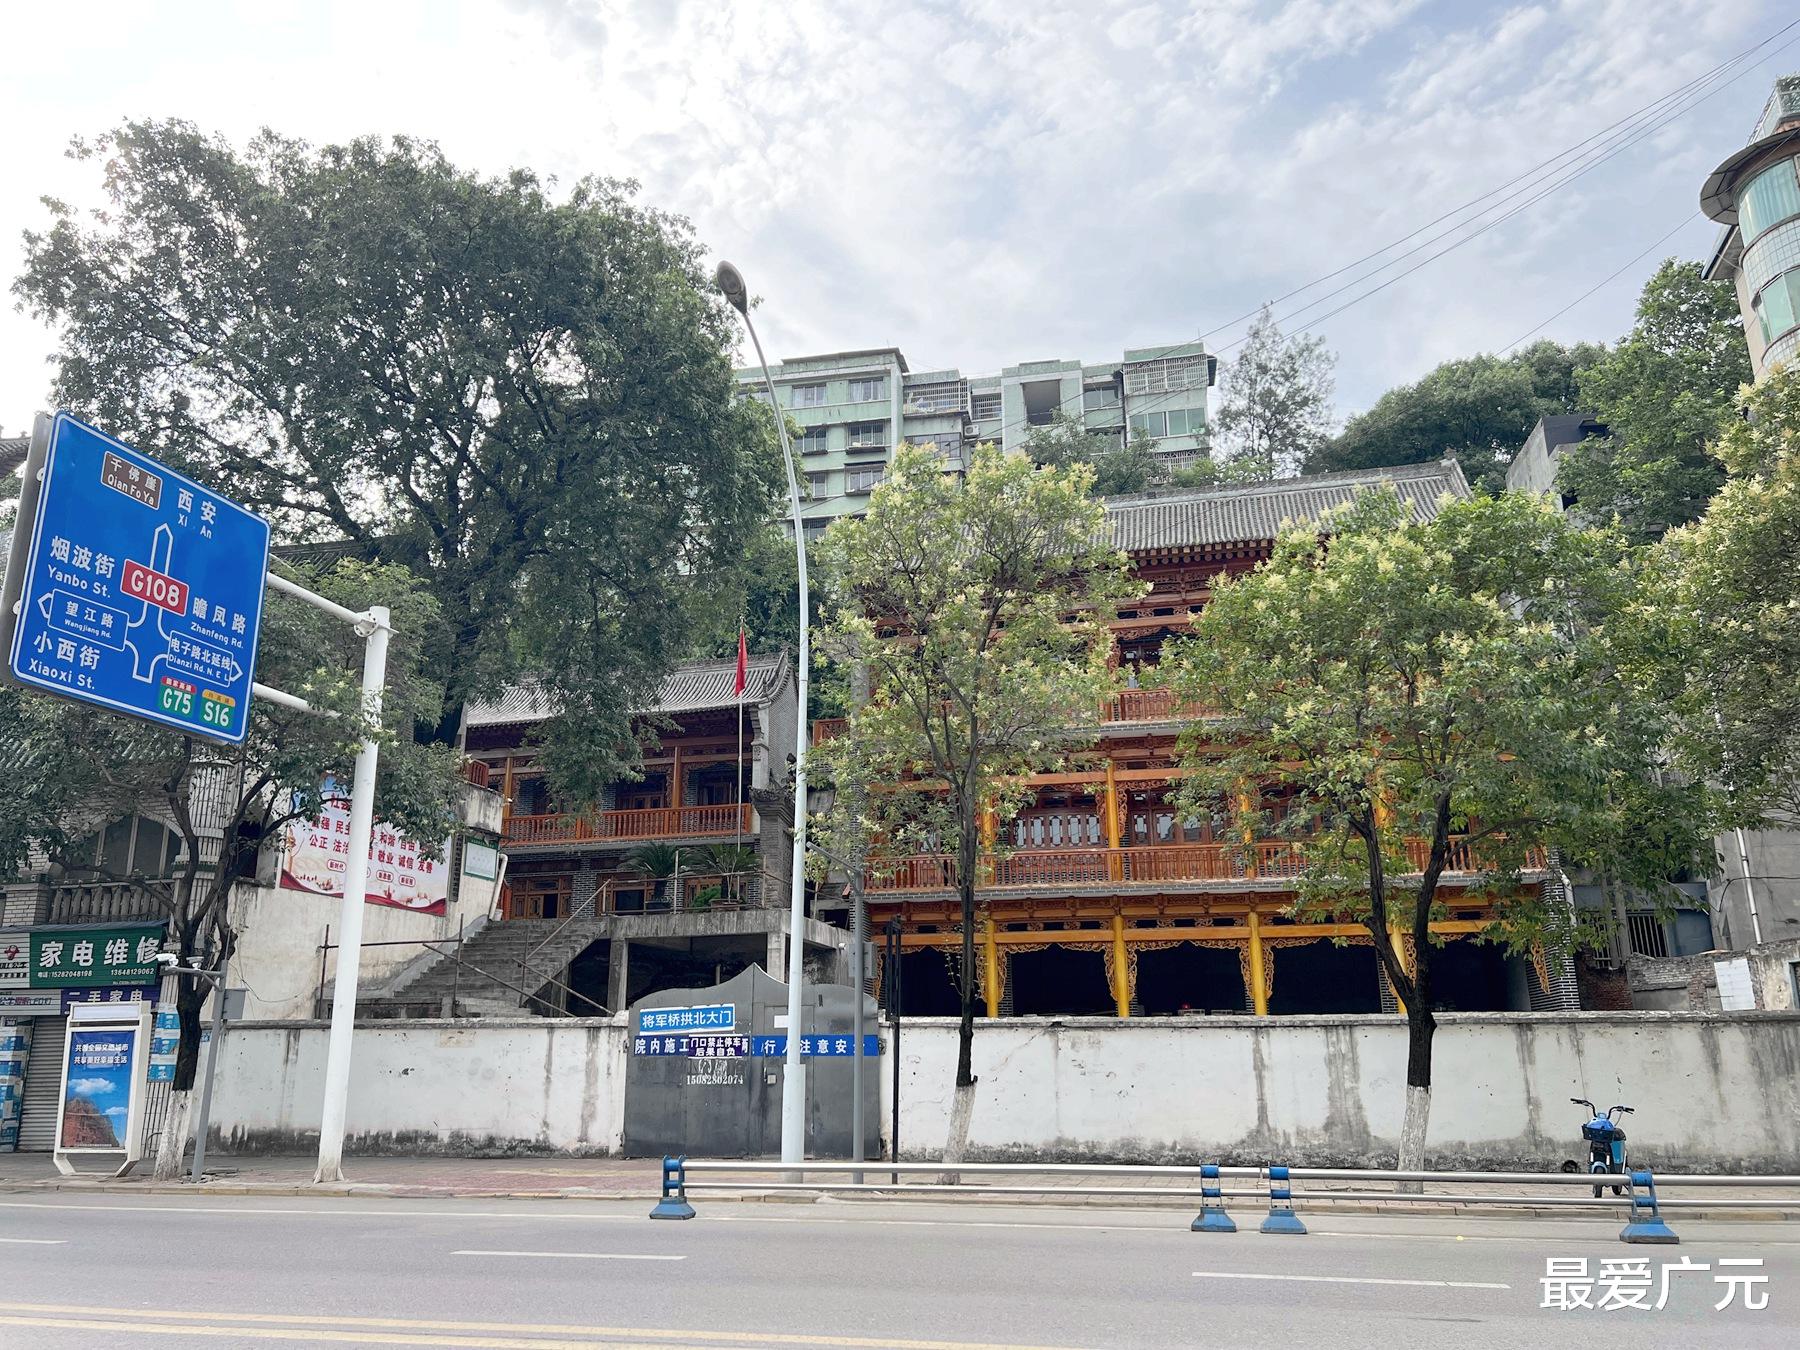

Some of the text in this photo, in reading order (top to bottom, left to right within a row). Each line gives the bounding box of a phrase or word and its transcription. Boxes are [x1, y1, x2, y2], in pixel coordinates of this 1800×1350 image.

[110, 457, 157, 491] 千佛崖
[107, 474, 154, 506] Qian Fo Ya
[177, 487, 216, 525] 西安
[200, 525, 212, 539] An
[50, 535, 115, 579] 烟波街
[47, 564, 111, 598] Yanbo St.
[131, 569, 180, 607] G108
[65, 600, 113, 628] 望江路
[64, 619, 112, 639] Wangjiang Rd.
[190, 621, 244, 649] Zhanfeng Rd.
[33, 631, 100, 670] 小西街
[168, 654, 193, 668] Dianzi
[193, 663, 205, 673] Rd.
[170, 637, 231, 671] 电子路北延线
[29, 658, 95, 690] Xiaoxi St.
[163, 688, 192, 715] G75
[203, 701, 230, 727] S16
[380, 831, 396, 847] 和谐
[309, 834, 328, 849] 公正
[377, 850, 394, 865] 敬业
[398, 855, 414, 870] 诚信
[418, 858, 433, 874] 友善
[39, 935, 160, 968] 家电维修
[68, 989, 143, 1002] 二手家电
[642, 1010, 731, 1028] 将军桥拱北大门
[635, 1038, 689, 1054] 院内施工
[764, 1039, 865, 1054] 行注意安
[690, 1037, 741, 1048] 门口禁止停车
[694, 1047, 736, 1056] 后果自负
